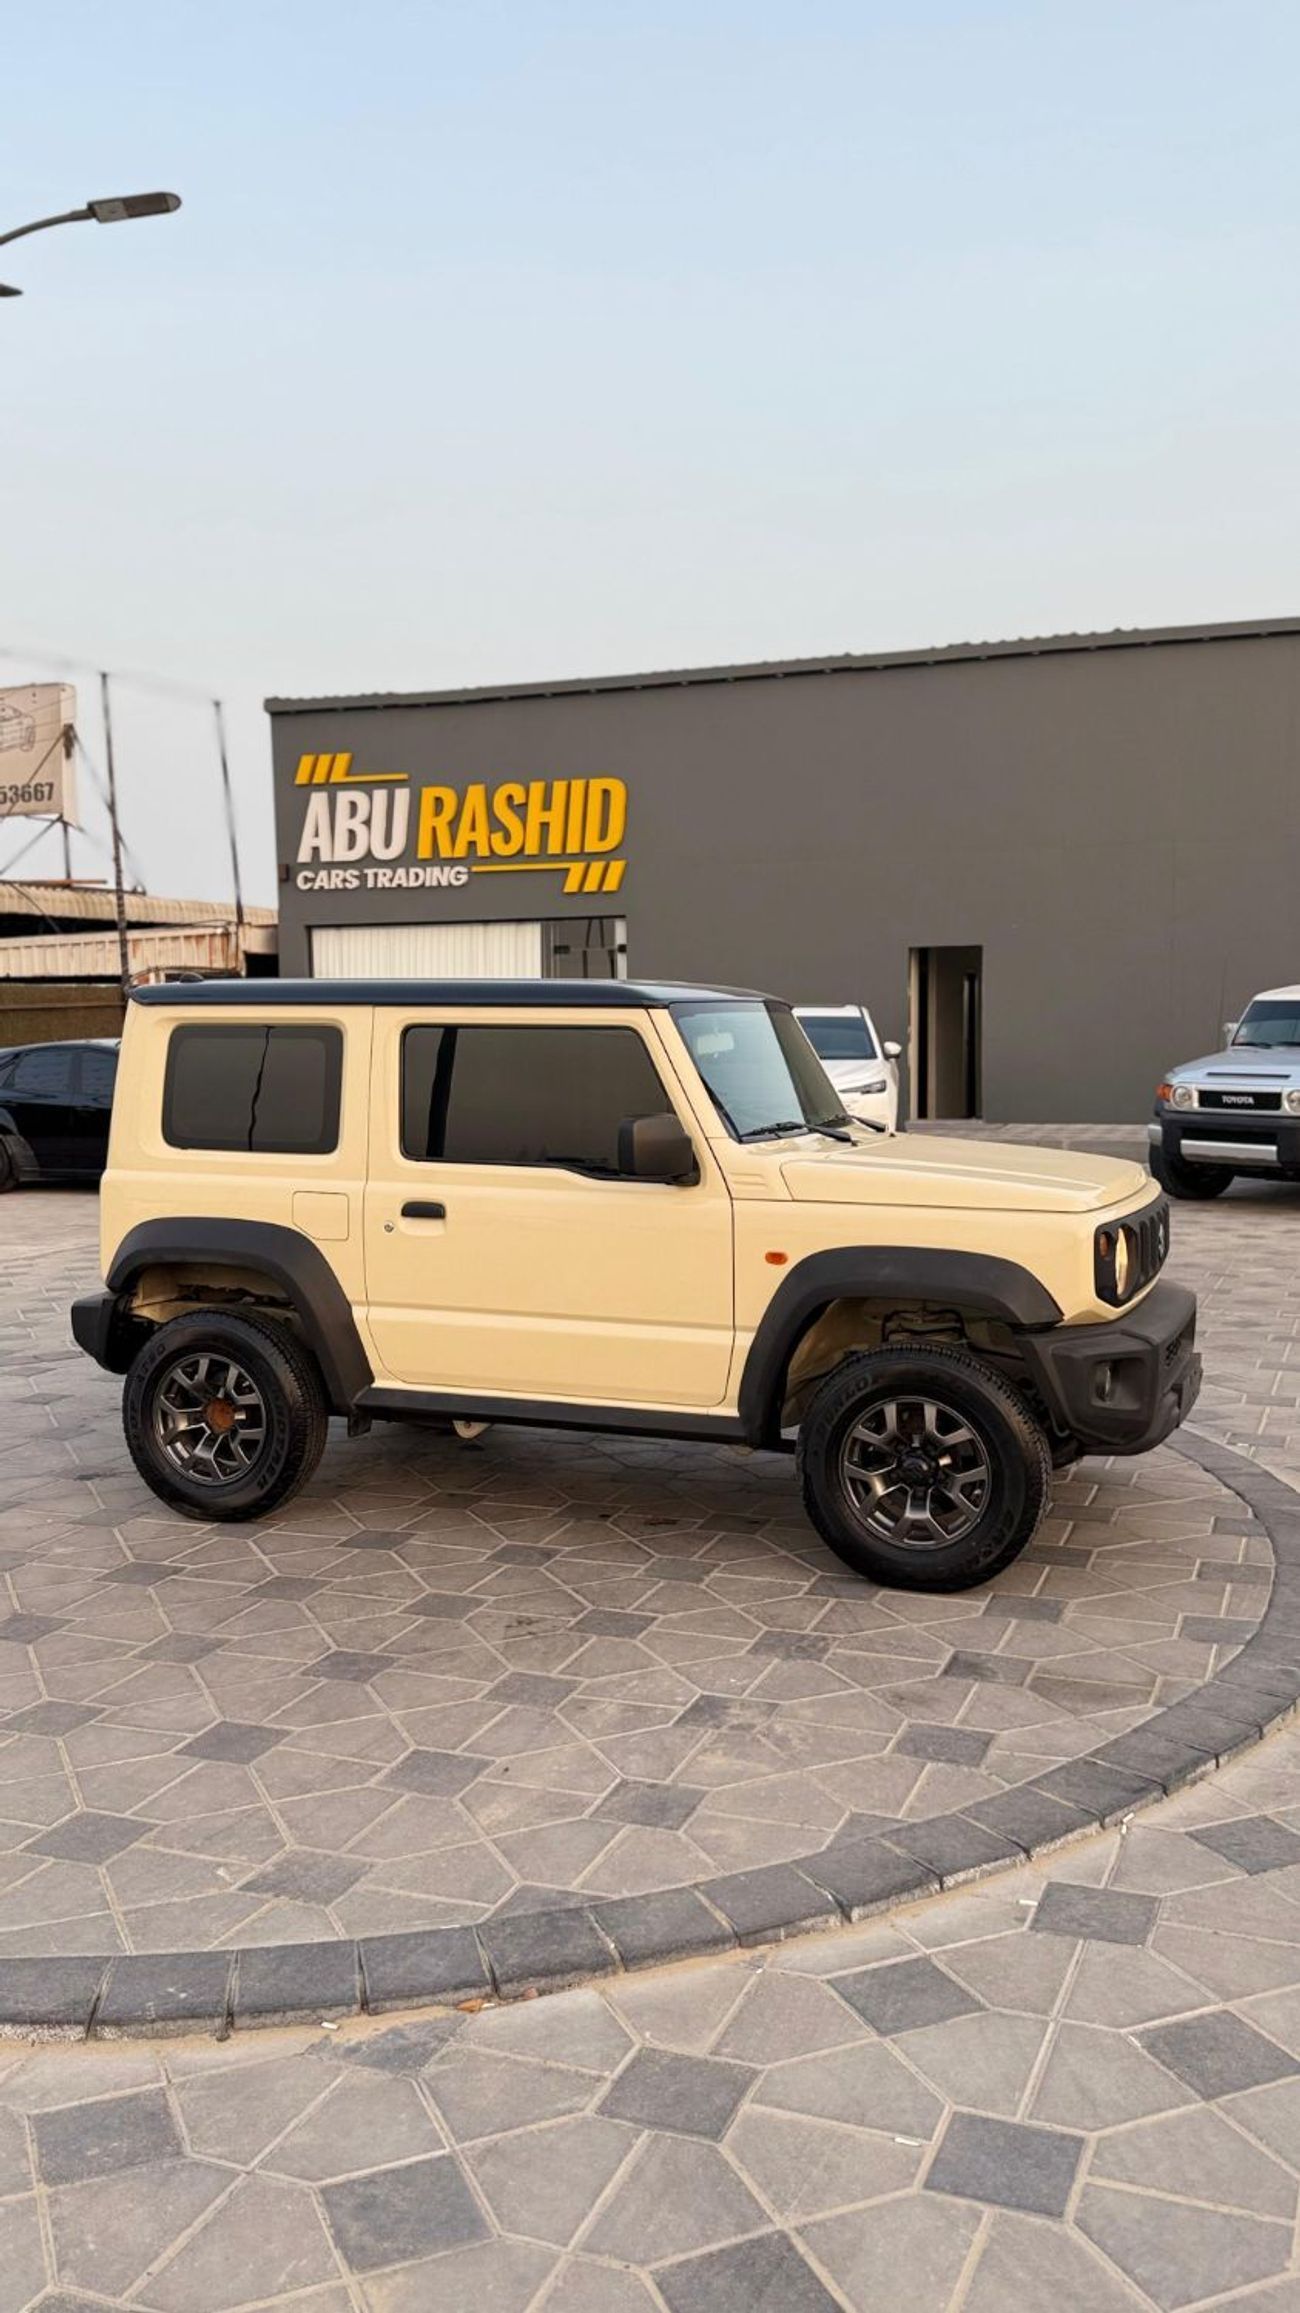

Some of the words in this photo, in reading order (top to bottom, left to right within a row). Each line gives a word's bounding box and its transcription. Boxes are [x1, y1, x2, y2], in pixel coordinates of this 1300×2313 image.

[0, 782, 54, 804] 53667
[296, 787, 410, 863] ABU
[416, 777, 627, 859] RASHID
[296, 869, 360, 890] CARS
[364, 865, 469, 888] TRADING
[1222, 1095, 1254, 1105] TOYOTA
